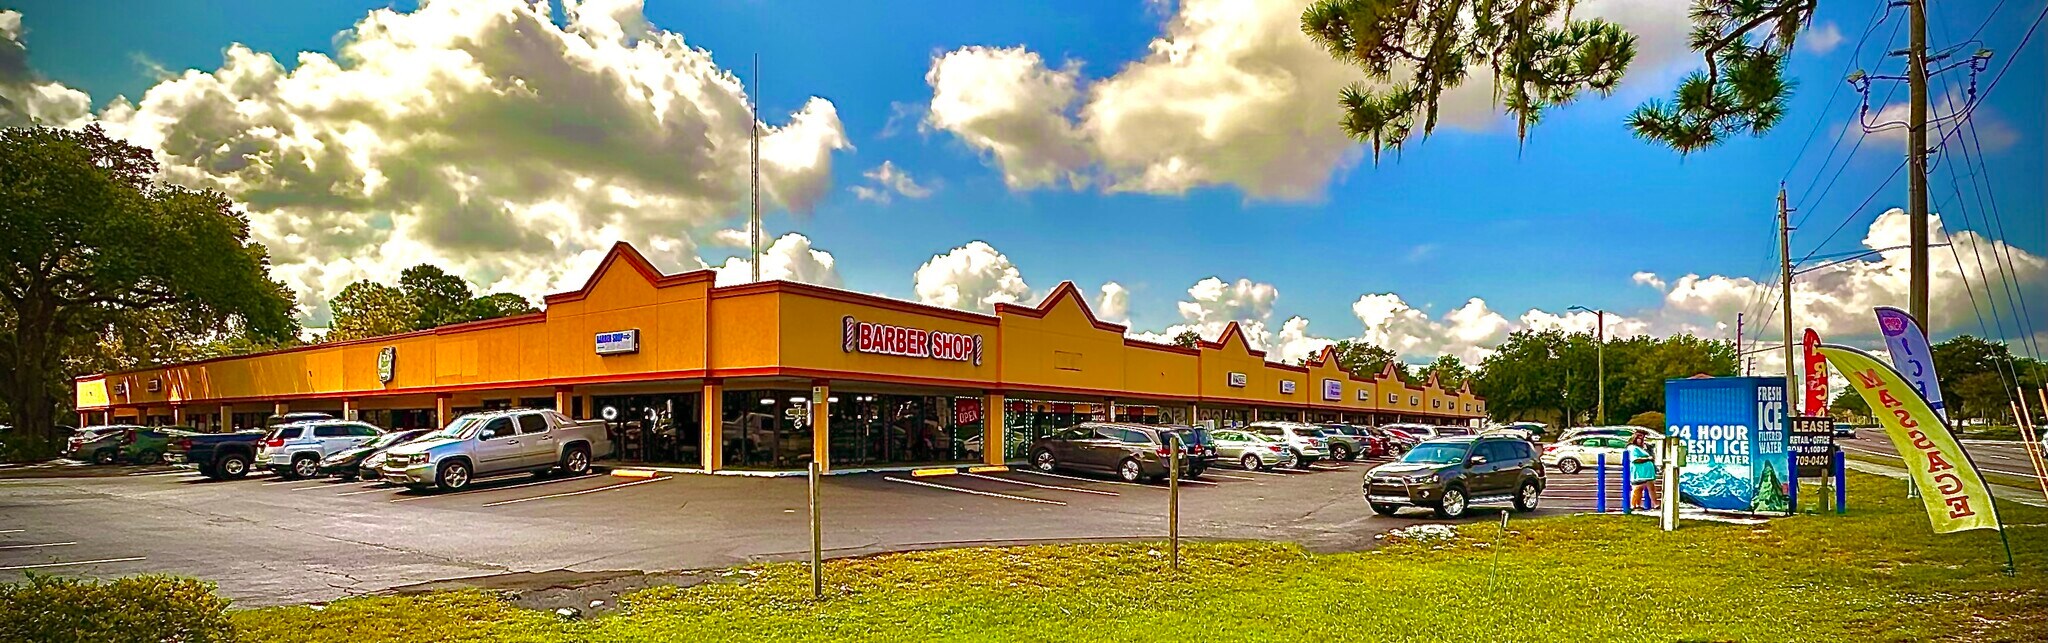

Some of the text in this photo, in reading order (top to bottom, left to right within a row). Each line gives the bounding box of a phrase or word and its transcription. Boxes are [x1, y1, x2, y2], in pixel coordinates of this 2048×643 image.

[860, 322, 973, 360] BARBER SHOP
[1757, 386, 1782, 401] FRESH
[959, 410, 978, 423] OPEN
[1758, 401, 1782, 431] ICE
[1669, 425, 1749, 441] 24 HOUR
[1793, 421, 1830, 433] LEASE
[1758, 431, 1782, 442] FILTERED
[1789, 435, 1830, 444] RETAIL OFFICE
[1679, 440, 1750, 455] ESH ICE
[1758, 442, 1782, 454] WATER
[1713, 455, 1750, 465] WATER
[1795, 455, 1829, 466] 709-0424
